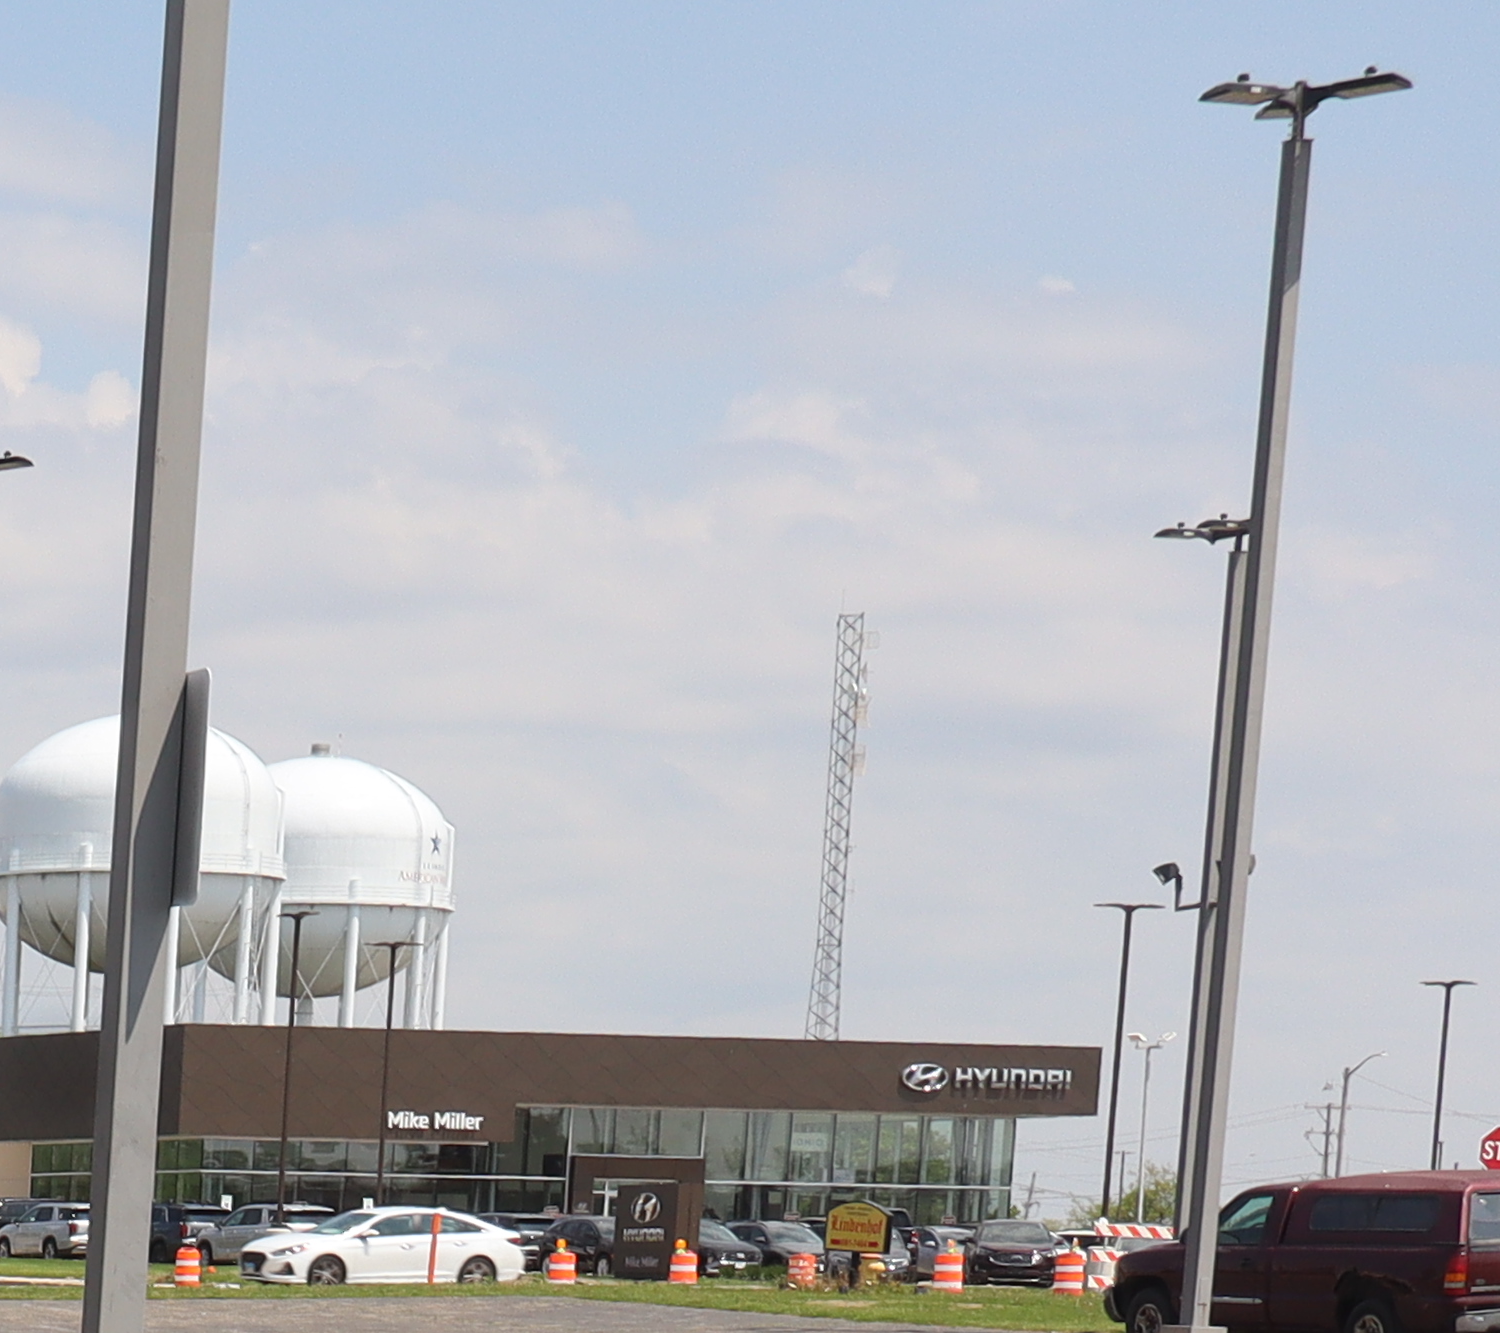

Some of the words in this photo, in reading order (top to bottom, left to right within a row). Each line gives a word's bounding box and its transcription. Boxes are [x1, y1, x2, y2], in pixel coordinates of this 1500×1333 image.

[955, 1067, 1072, 1090] HYUNDAI
[387, 1111, 429, 1129] Mike
[434, 1112, 484, 1130] Miller
